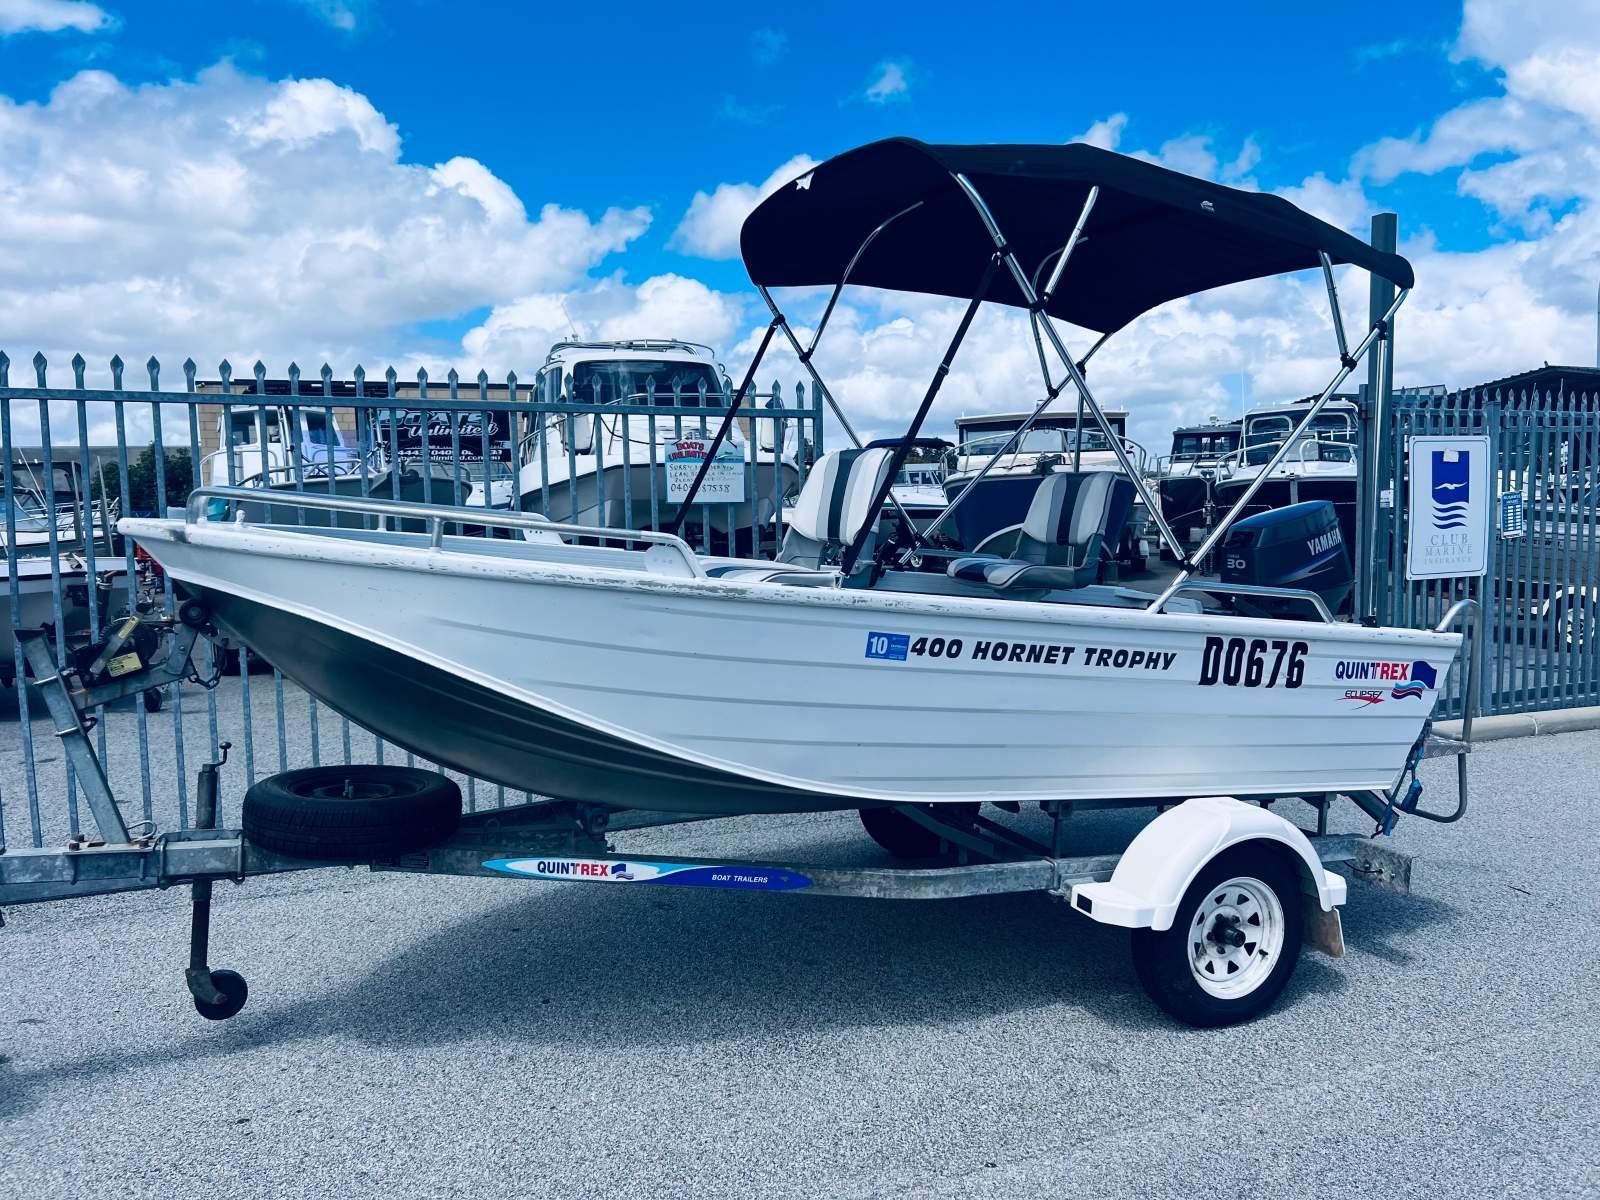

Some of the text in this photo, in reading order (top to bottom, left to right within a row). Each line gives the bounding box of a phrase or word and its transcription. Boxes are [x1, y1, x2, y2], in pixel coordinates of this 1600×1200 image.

[1307, 527, 1342, 556] YAMAHA
[1430, 533, 1468, 546] CLUB
[1425, 544, 1472, 556] MARINE
[1227, 559, 1246, 569] 30
[870, 636, 888, 655] 10
[910, 636, 1177, 671] 400 HORNET TROPHY
[1335, 661, 1409, 681] QUINTREX
[1345, 690, 1383, 699] ECLIPSE
[537, 860, 609, 877] QUINTREX
[734, 875, 768, 884] TRAILERS
